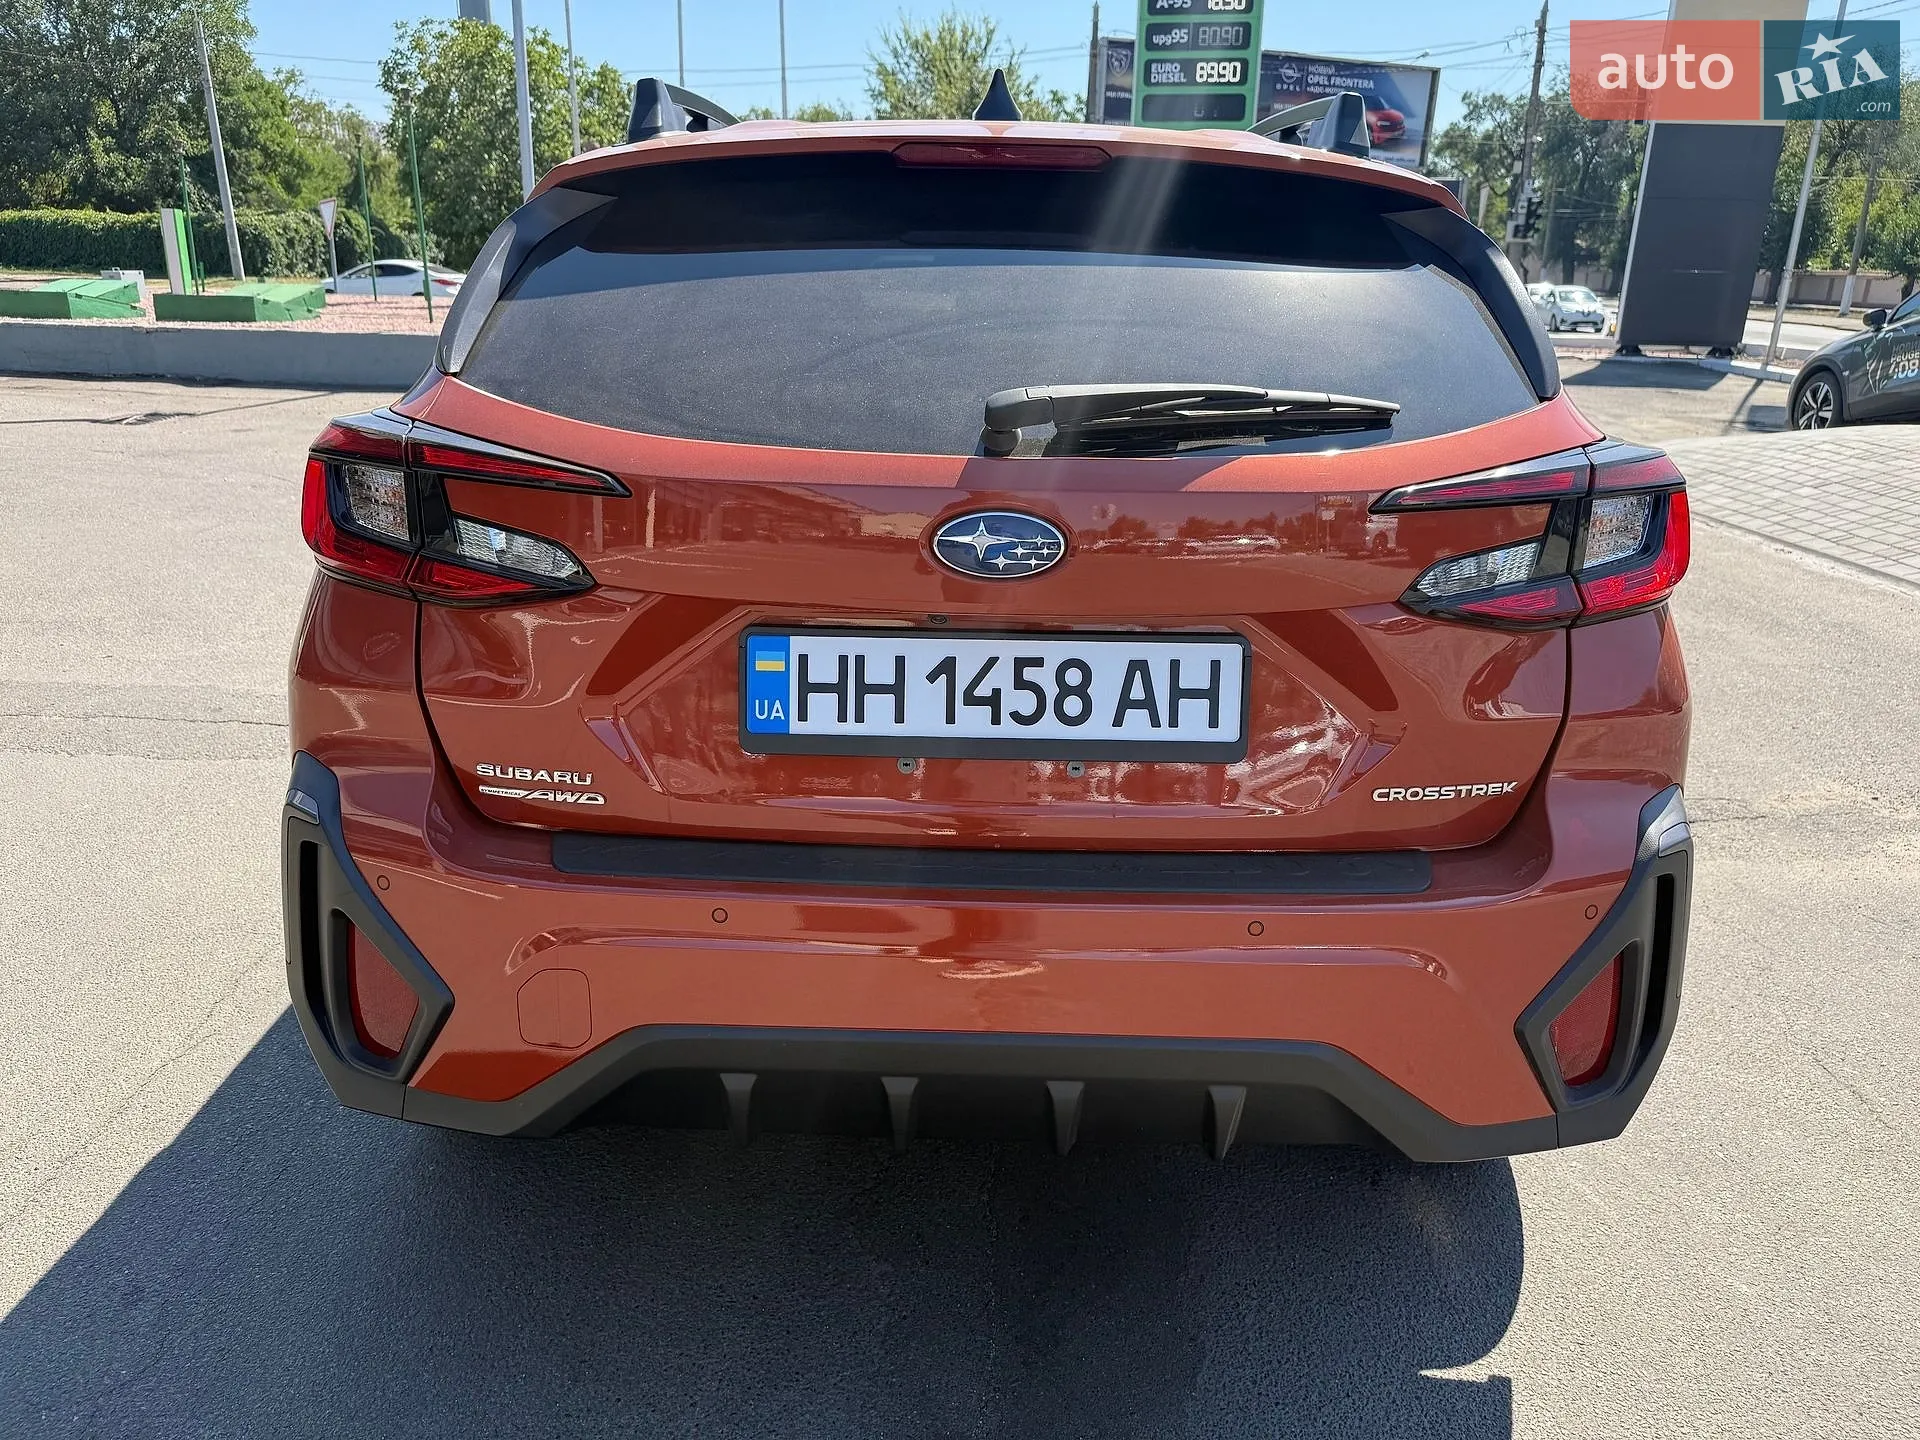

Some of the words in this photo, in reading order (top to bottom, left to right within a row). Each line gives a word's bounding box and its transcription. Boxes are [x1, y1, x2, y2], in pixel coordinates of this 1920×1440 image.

[1152, 28, 1189, 46] upg95
[1151, 62, 1181, 73] EURO
[1150, 72, 1187, 83] DIESEL
[1307, 75, 1330, 86] OPEL
[1330, 77, 1374, 90] FRONTERA
[755, 700, 786, 721] UA
[797, 653, 906, 724] HH
[925, 655, 1093, 727] 1458
[1111, 658, 1222, 729] AH
[476, 763, 592, 785] SUBARU
[525, 789, 605, 804] AWD
[1372, 781, 1518, 802] CROSSTREK
